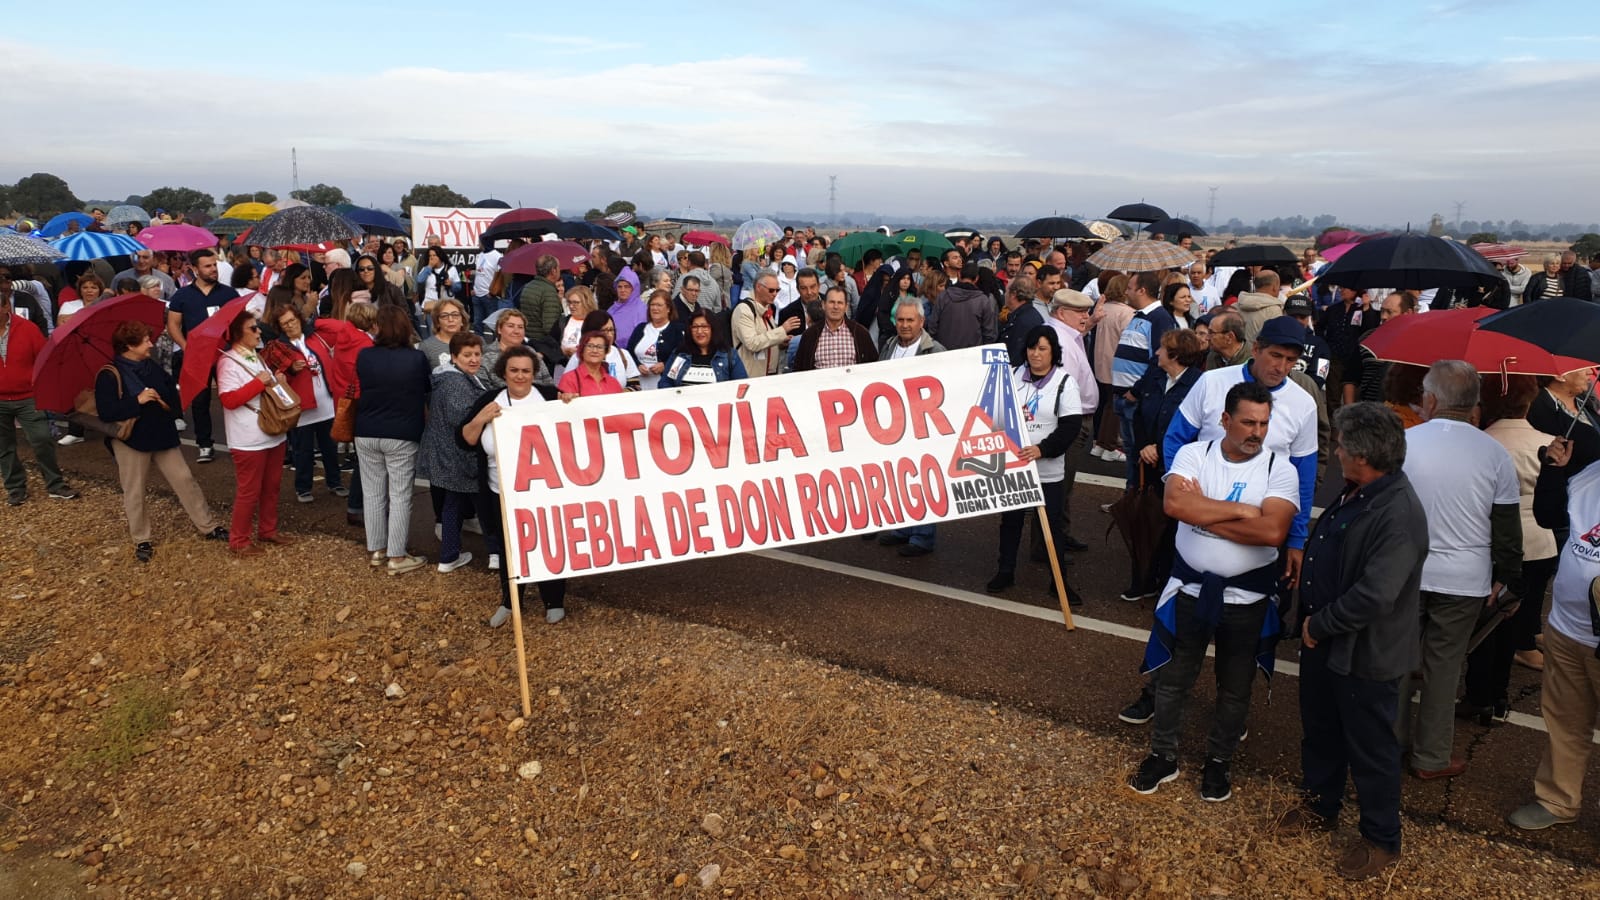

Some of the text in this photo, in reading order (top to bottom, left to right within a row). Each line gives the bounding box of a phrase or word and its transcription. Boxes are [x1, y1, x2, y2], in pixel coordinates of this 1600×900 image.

[986, 350, 1010, 363] A-43
[514, 375, 956, 493] AUTOVÍA POR
[961, 435, 1005, 455] N-430
[950, 470, 1039, 502] NACIONAL
[955, 488, 1043, 515] DIGNA Y SEGURA
[515, 453, 950, 578] PUEBLA DE DON RODRIGO
[1570, 541, 1600, 559] TOVIA
